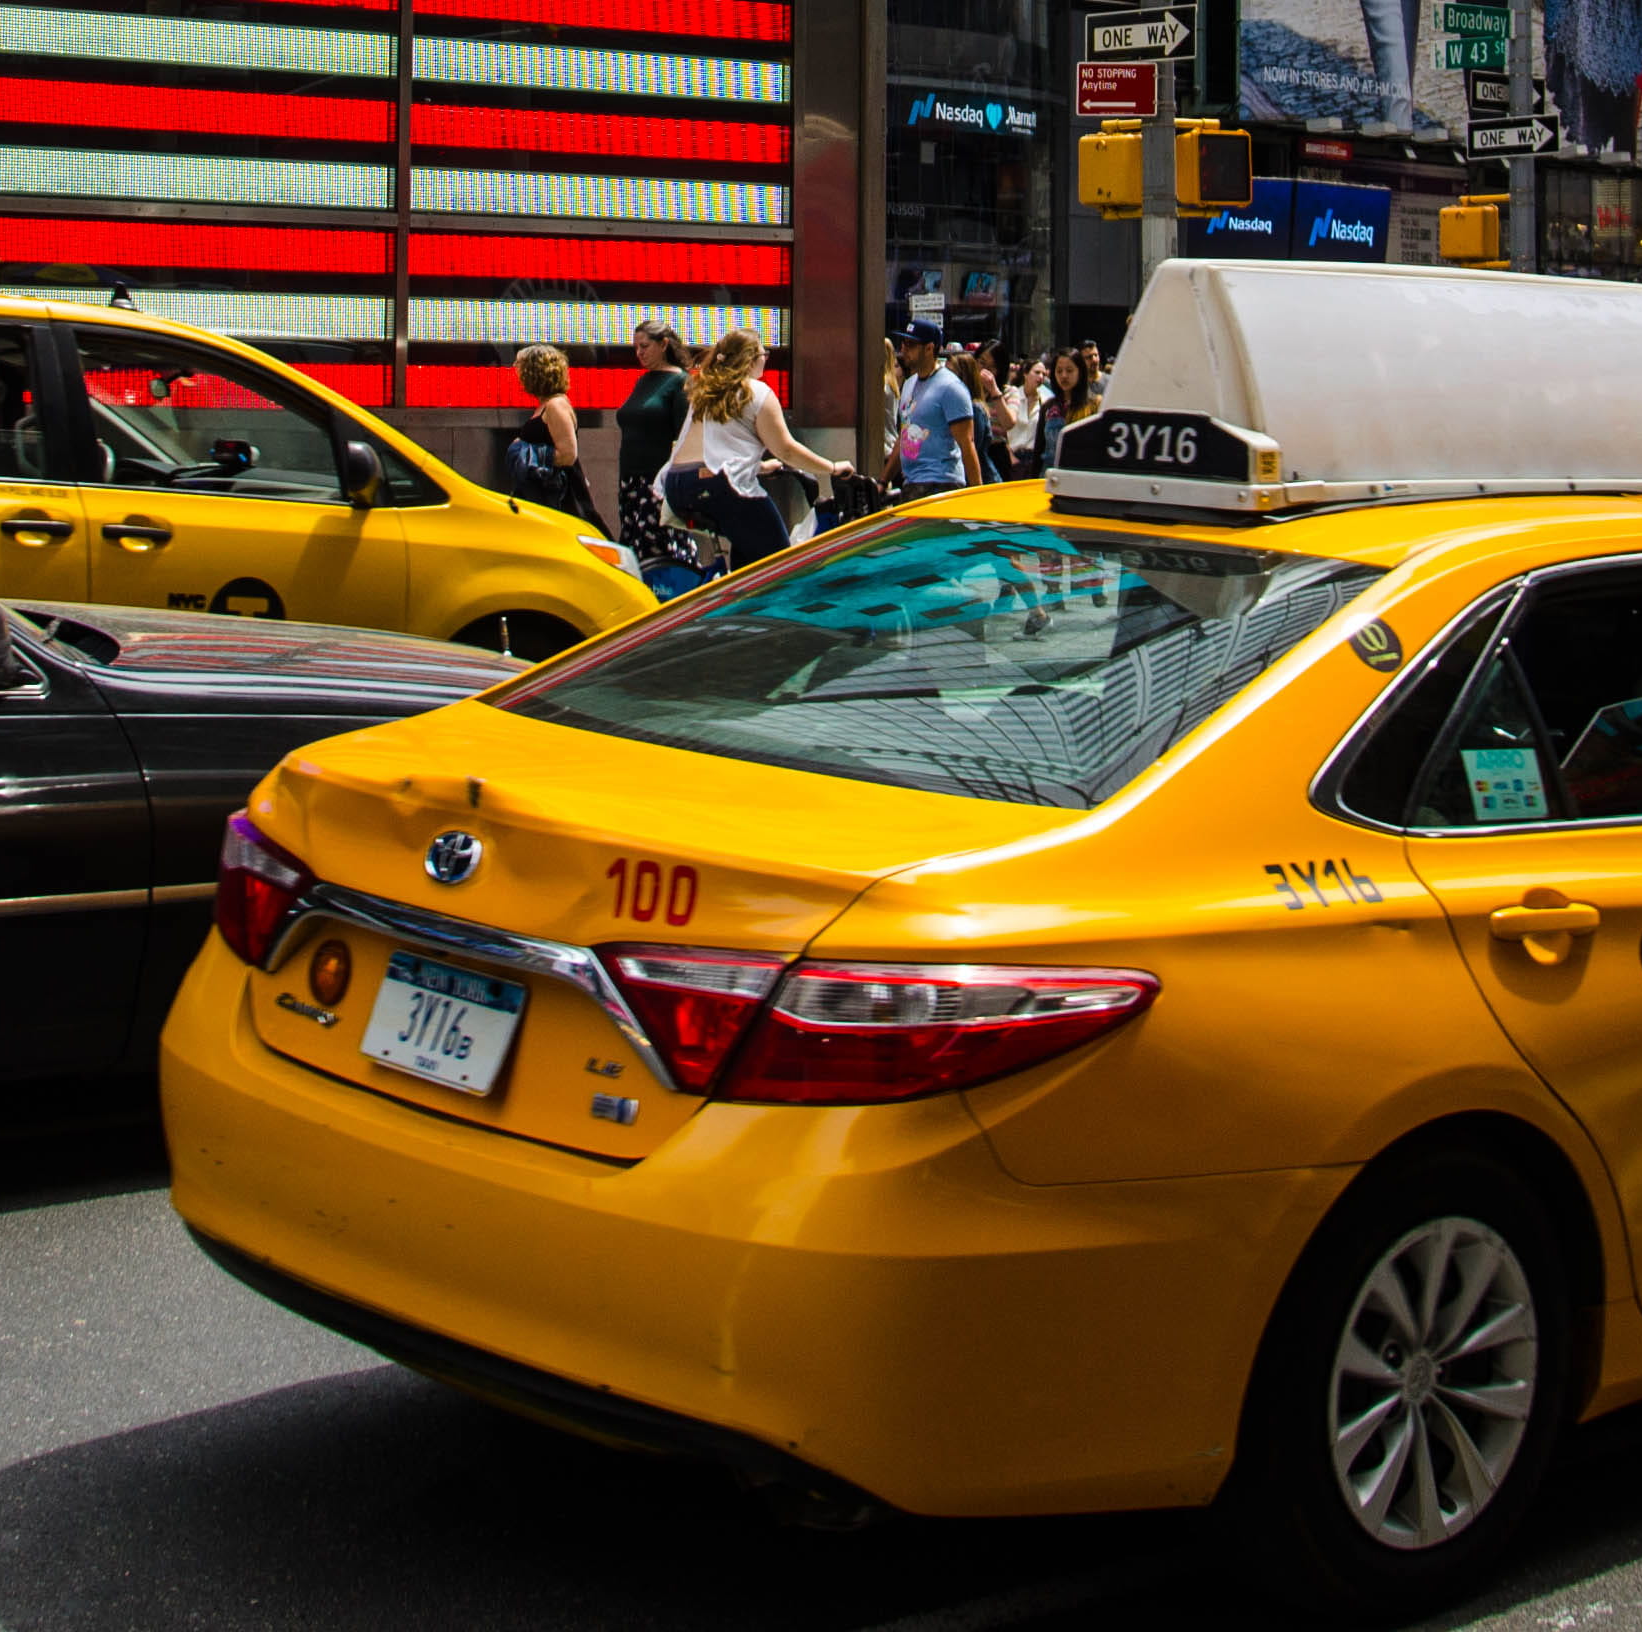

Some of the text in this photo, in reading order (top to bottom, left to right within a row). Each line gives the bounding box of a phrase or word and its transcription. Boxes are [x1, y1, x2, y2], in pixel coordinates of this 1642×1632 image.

[1448, 8, 1507, 37] Broadway
[1102, 23, 1179, 48] ONE WAY
[1449, 40, 1505, 65] W 43 St
[1081, 68, 1137, 79] NO STOPPING
[1082, 81, 1117, 91] Anytime
[1263, 66, 1287, 83] NOW
[1289, 69, 1300, 85] IN
[1301, 70, 1338, 89] STORES
[1340, 76, 1360, 92] AND
[1362, 79, 1373, 93] AT
[1482, 83, 1504, 100] ONE
[935, 102, 984, 128] Nasdaq
[1480, 128, 1545, 146] ONE WAY
[1228, 216, 1272, 235] Nasdaq
[1330, 220, 1374, 248] Nasdaq
[1108, 422, 1198, 464] 3Y16
[167, 593, 206, 610] NYC
[605, 856, 699, 928] 100
[1263, 858, 1384, 910] 3Y16
